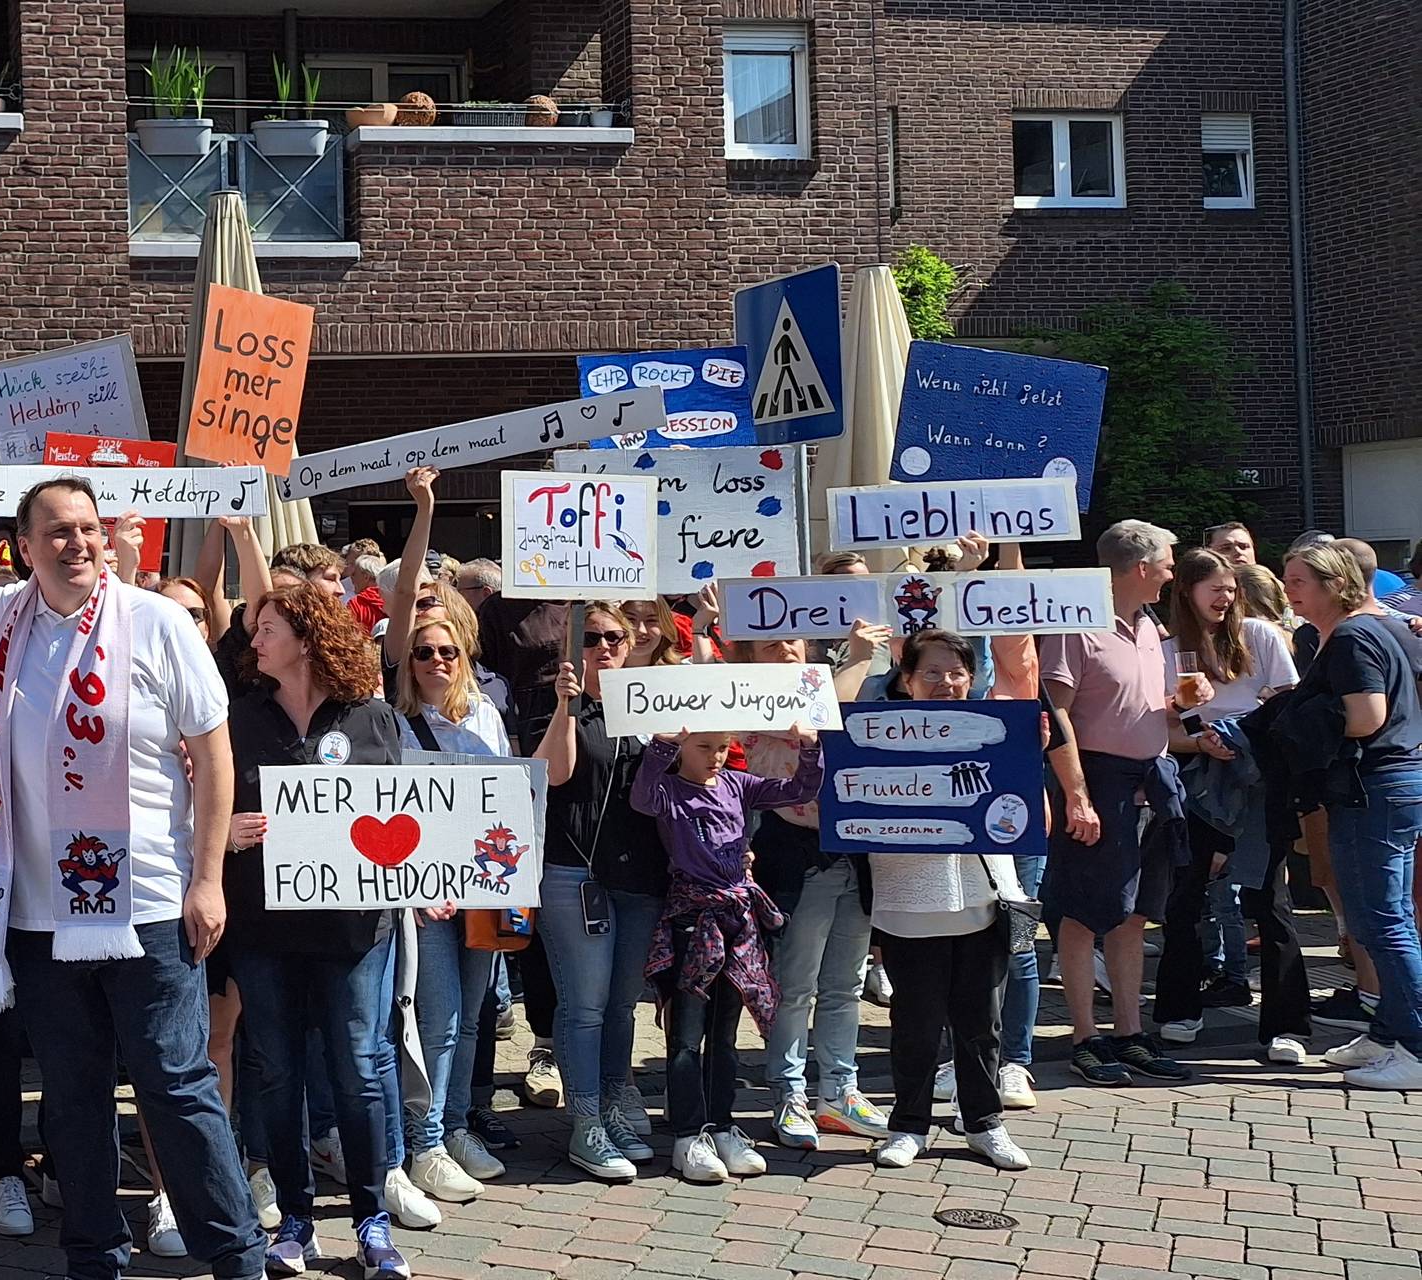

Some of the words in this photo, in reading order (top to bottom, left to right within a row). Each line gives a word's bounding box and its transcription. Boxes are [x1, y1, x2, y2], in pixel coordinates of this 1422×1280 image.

[213, 307, 295, 369] Loss
[223, 365, 282, 402] mer
[591, 369, 627, 388] IHR
[635, 366, 692, 385] ROCKT
[706, 363, 743, 384] DIE
[915, 368, 962, 392] Wenn
[197, 397, 295, 460] singe
[927, 423, 972, 446] Wann
[300, 465, 322, 491] Op
[328, 455, 358, 478] dem
[405, 447, 427, 469] op
[430, 434, 463, 458] dem
[468, 425, 507, 450] maat
[130, 476, 221, 516] Hetdörp
[712, 462, 766, 494] loss
[527, 482, 625, 550] Toffi
[850, 490, 1055, 542] Lieblings
[516, 526, 577, 551] Jungfrau
[678, 513, 766, 563] fiere
[547, 551, 570, 570] met
[575, 550, 645, 583] Humor
[747, 586, 856, 631] Drei
[962, 579, 1094, 628] Gestirn
[626, 681, 713, 716] Bauer
[720, 680, 807, 722] Jürgen
[865, 716, 952, 742] Echte
[275, 777, 356, 815] MER
[375, 776, 455, 814] HAN
[481, 776, 499, 814] E
[842, 772, 934, 798] Fründe
[879, 824, 944, 837] zesamme
[276, 859, 340, 903] FÖR
[358, 860, 475, 903] HETDÖRP
